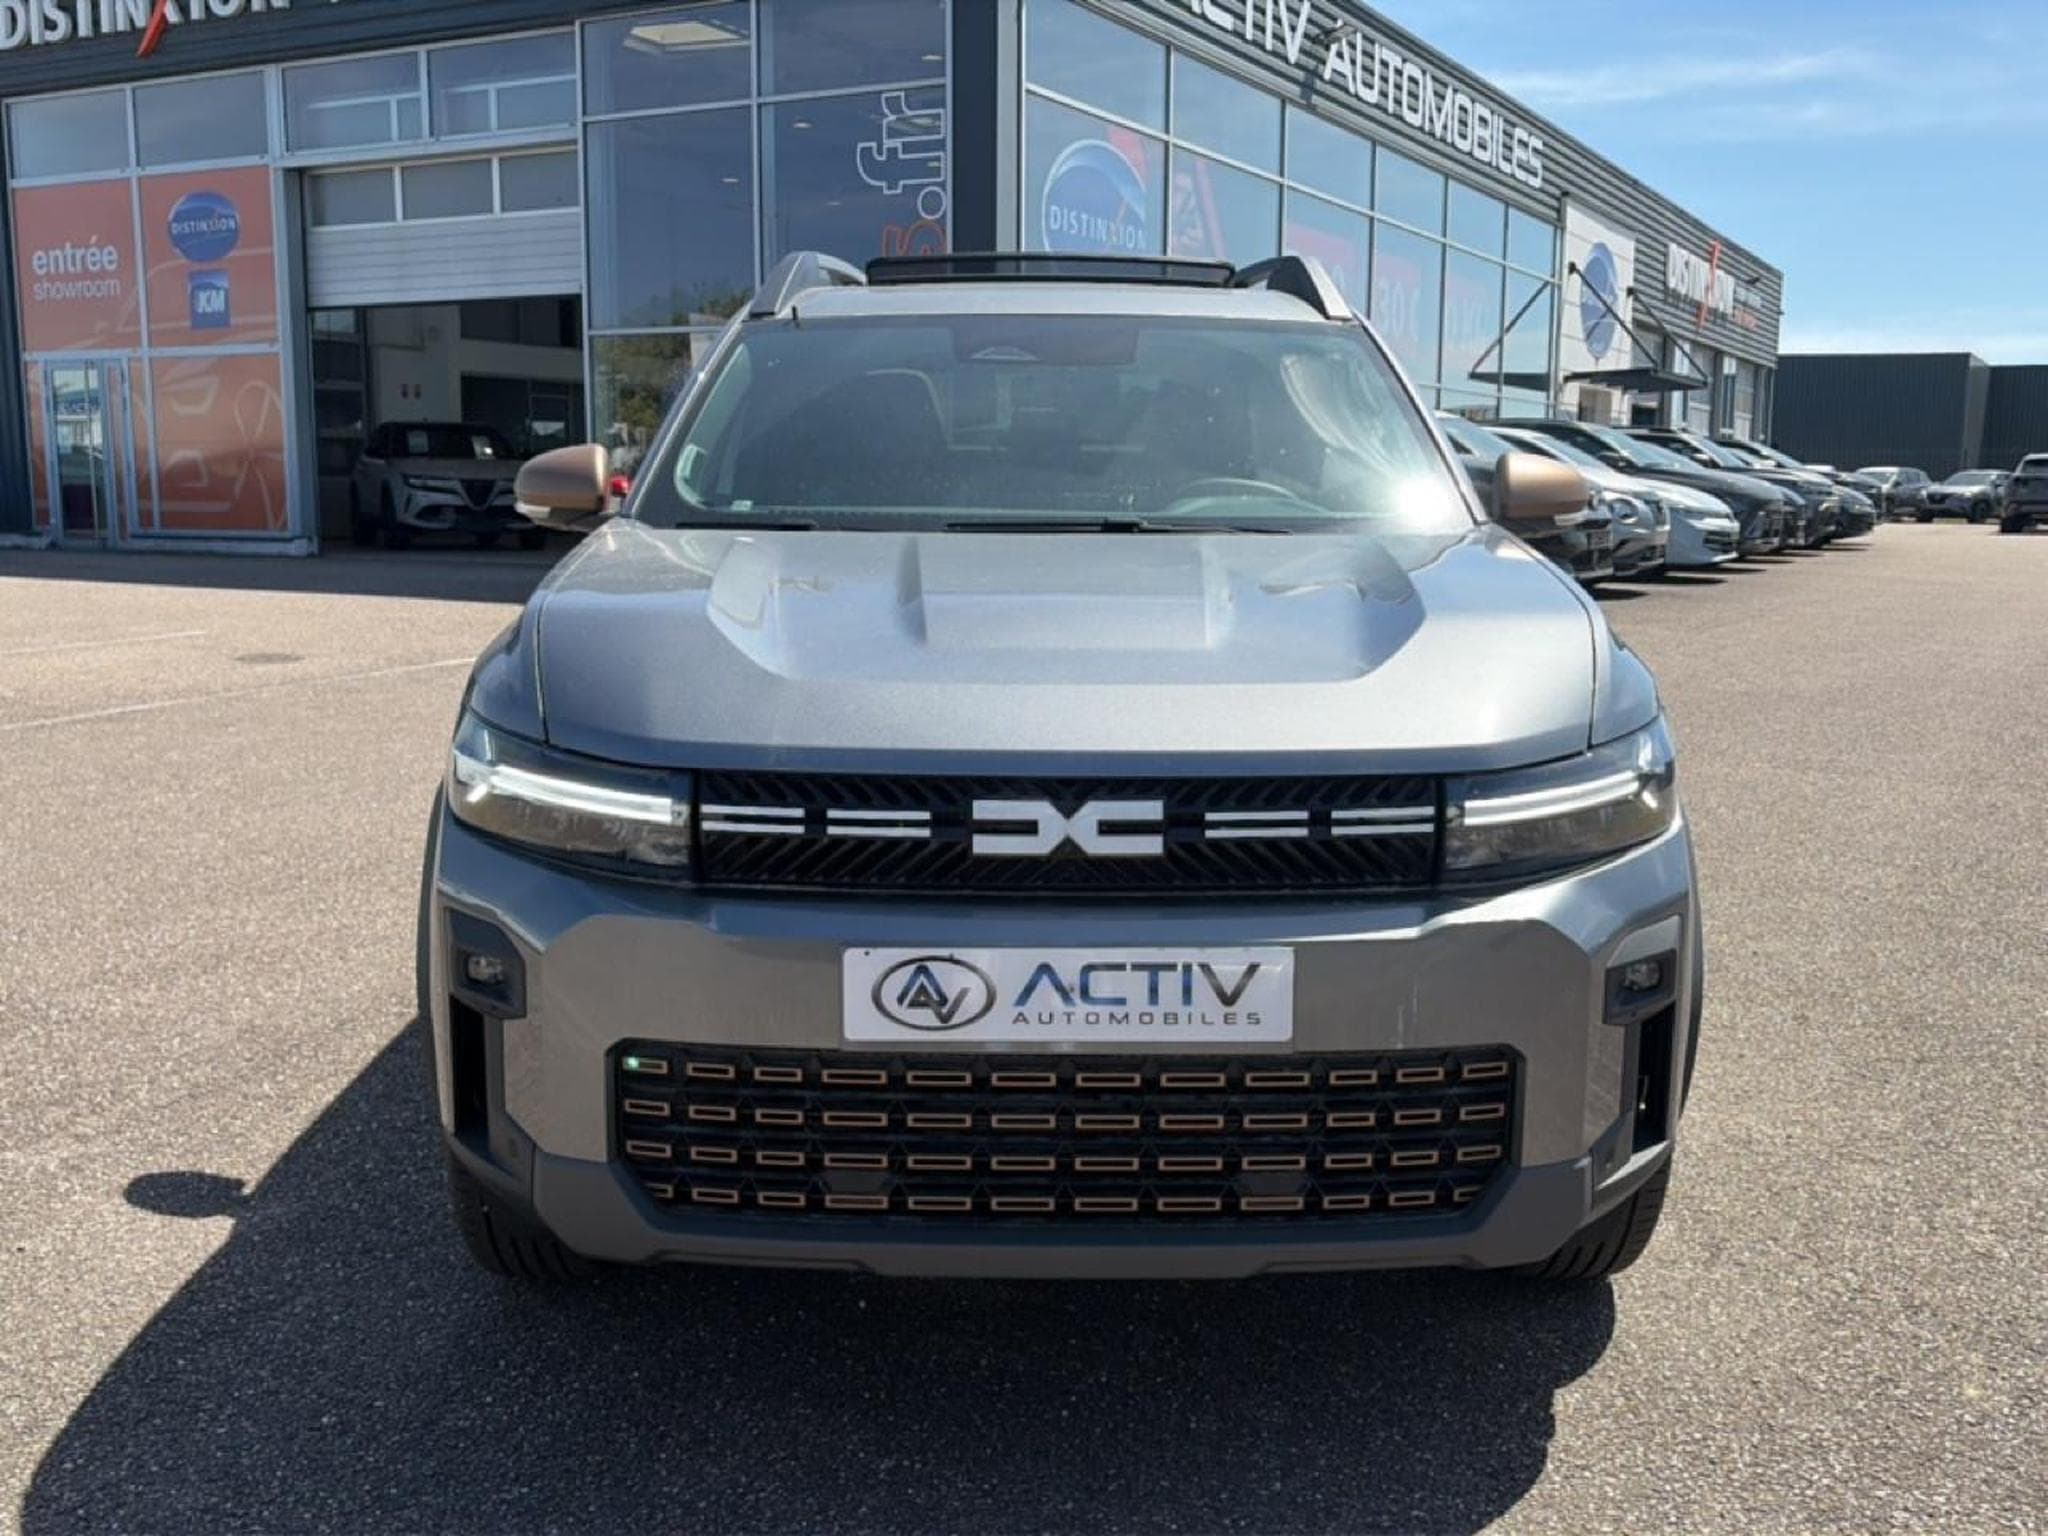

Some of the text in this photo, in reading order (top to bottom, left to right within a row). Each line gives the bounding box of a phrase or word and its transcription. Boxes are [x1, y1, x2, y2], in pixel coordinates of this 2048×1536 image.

[1323, 19, 1544, 189] AUTOMOBILES
[171, 217, 237, 235] DISTINXION
[32, 235, 119, 276] entrée
[33, 277, 121, 300] showroom
[1013, 961, 1262, 1007] ACTIV
[1012, 1011, 1262, 1025] AUTOMOBILES
